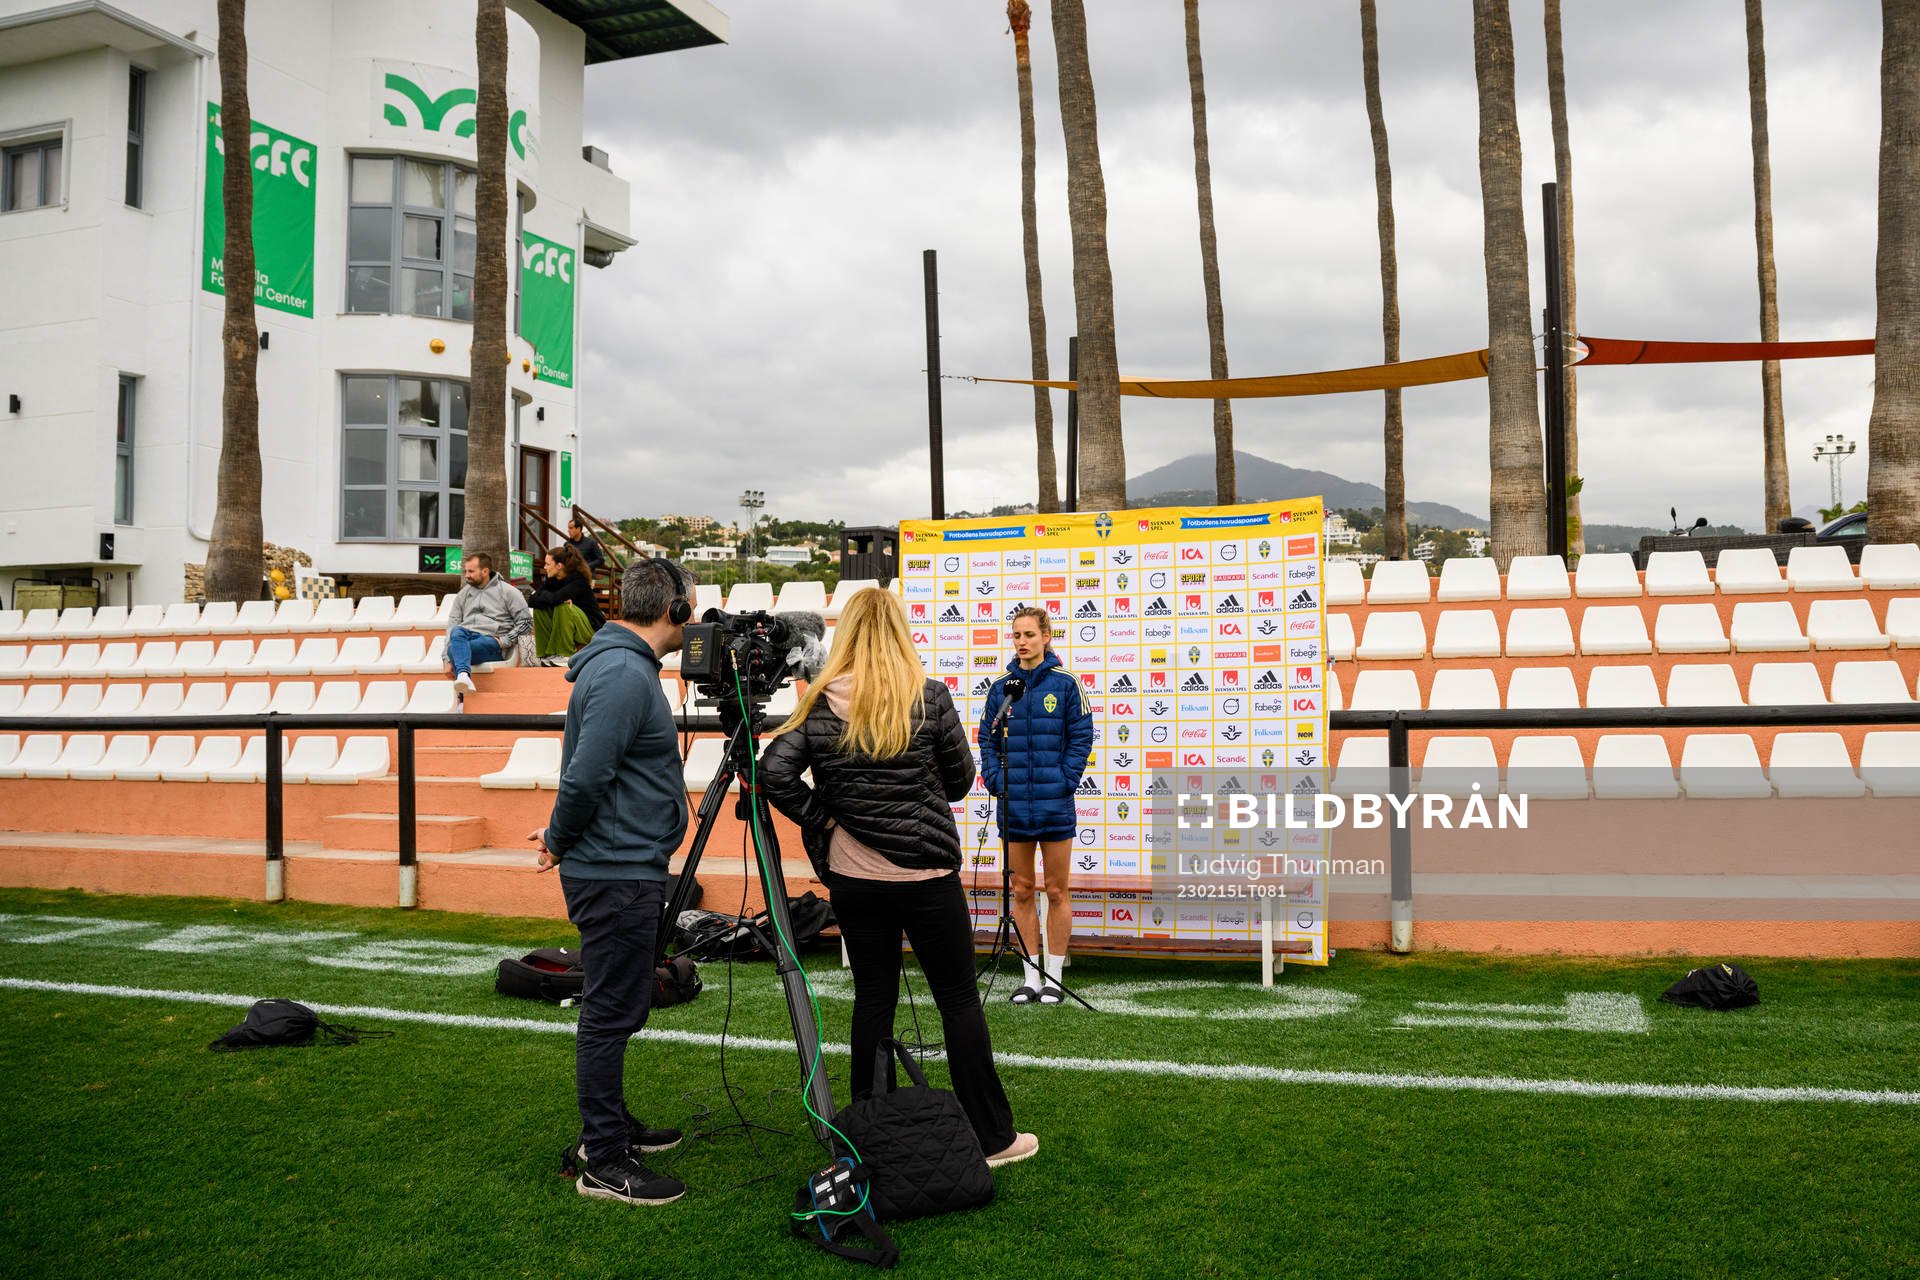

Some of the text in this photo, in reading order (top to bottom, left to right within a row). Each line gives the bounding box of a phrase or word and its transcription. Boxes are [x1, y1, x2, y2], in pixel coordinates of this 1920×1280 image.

[211, 256, 268, 285] Mlla
[265, 287, 308, 310] Center
[542, 364, 569, 381] Center
[1220, 517, 1263, 526] huvudsponsor
[949, 529, 1019, 539] Fotbollens huvudsponsor
[1182, 548, 1203, 560] ICA
[908, 560, 930, 568] SPORT
[1007, 560, 1031, 568] Fabege
[1181, 574, 1205, 582] SPORT
[1252, 572, 1278, 580] Scandic
[1289, 570, 1315, 579] Fabege
[1076, 579, 1100, 587] SPORT
[1289, 601, 1317, 610] adidas
[1075, 610, 1101, 618] adidas
[1146, 628, 1171, 638] Fabege
[1220, 624, 1241, 635] ICA
[912, 633, 928, 643] CA
[1291, 648, 1317, 658] Fabege
[940, 659, 964, 668] Fabege
[974, 656, 997, 664] SPORT
[1254, 682, 1282, 690] adidas
[1112, 704, 1134, 715] ICA
[1255, 703, 1281, 712] Fabege
[1294, 699, 1316, 711] ICA
[1184, 754, 1206, 765] ICA
[1293, 808, 1316, 819] Fabeg
[1145, 834, 1171, 844] Fabege
[1112, 909, 1133, 921] ICA
[1217, 914, 1244, 925] Fabege
